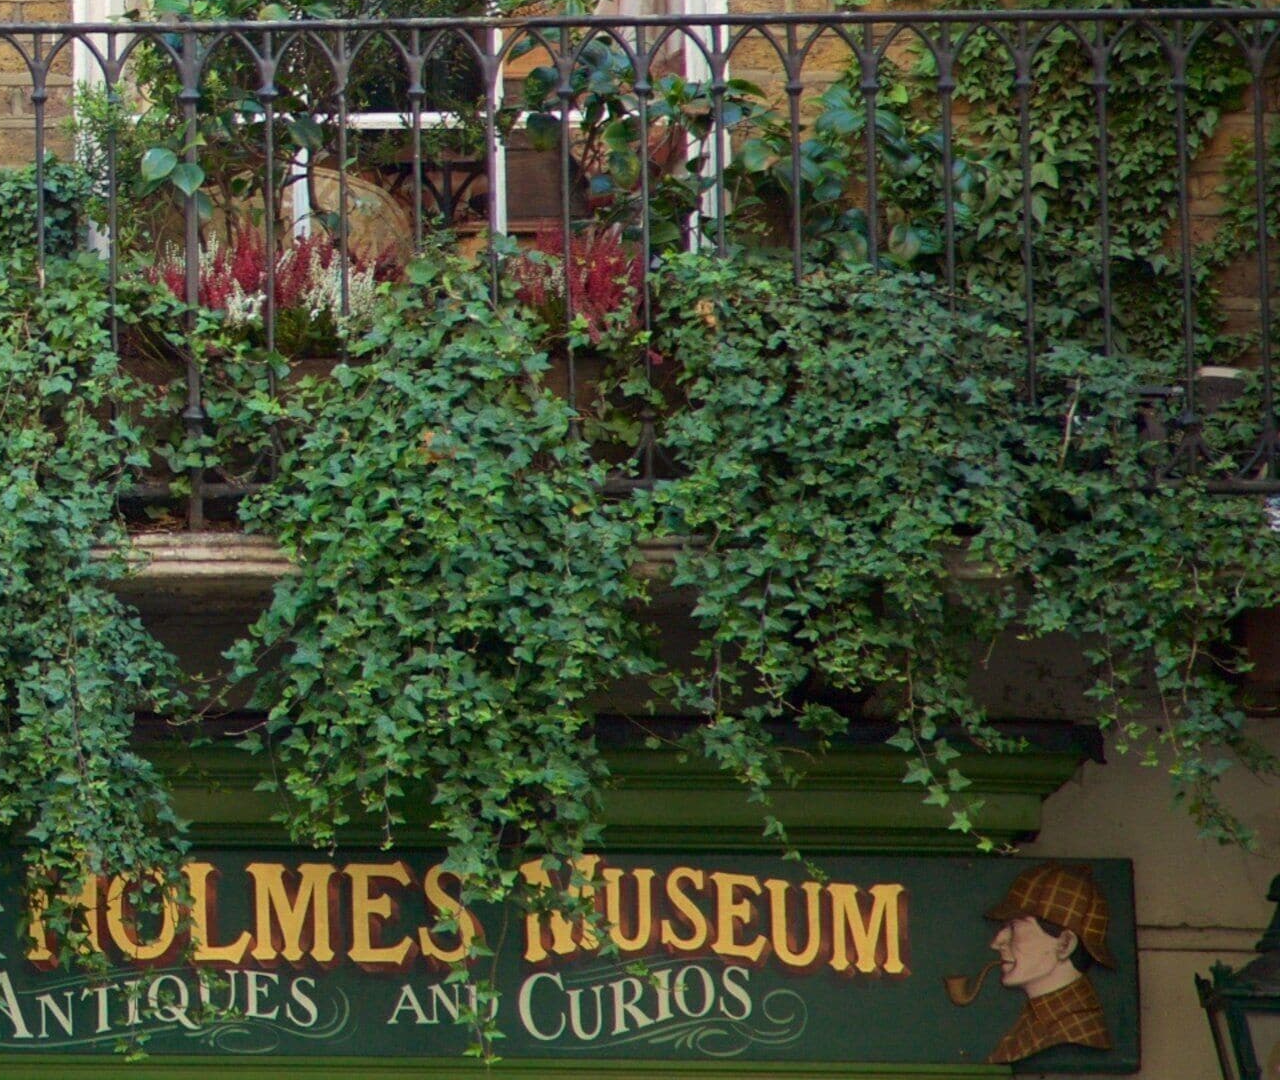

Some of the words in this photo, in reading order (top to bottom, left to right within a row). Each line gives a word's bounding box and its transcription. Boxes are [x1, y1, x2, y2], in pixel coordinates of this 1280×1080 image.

[26, 860, 477, 964] HOLMES
[519, 854, 907, 975] MUSEUM
[387, 983, 500, 1025] AND
[518, 965, 753, 1041] CURIOS
